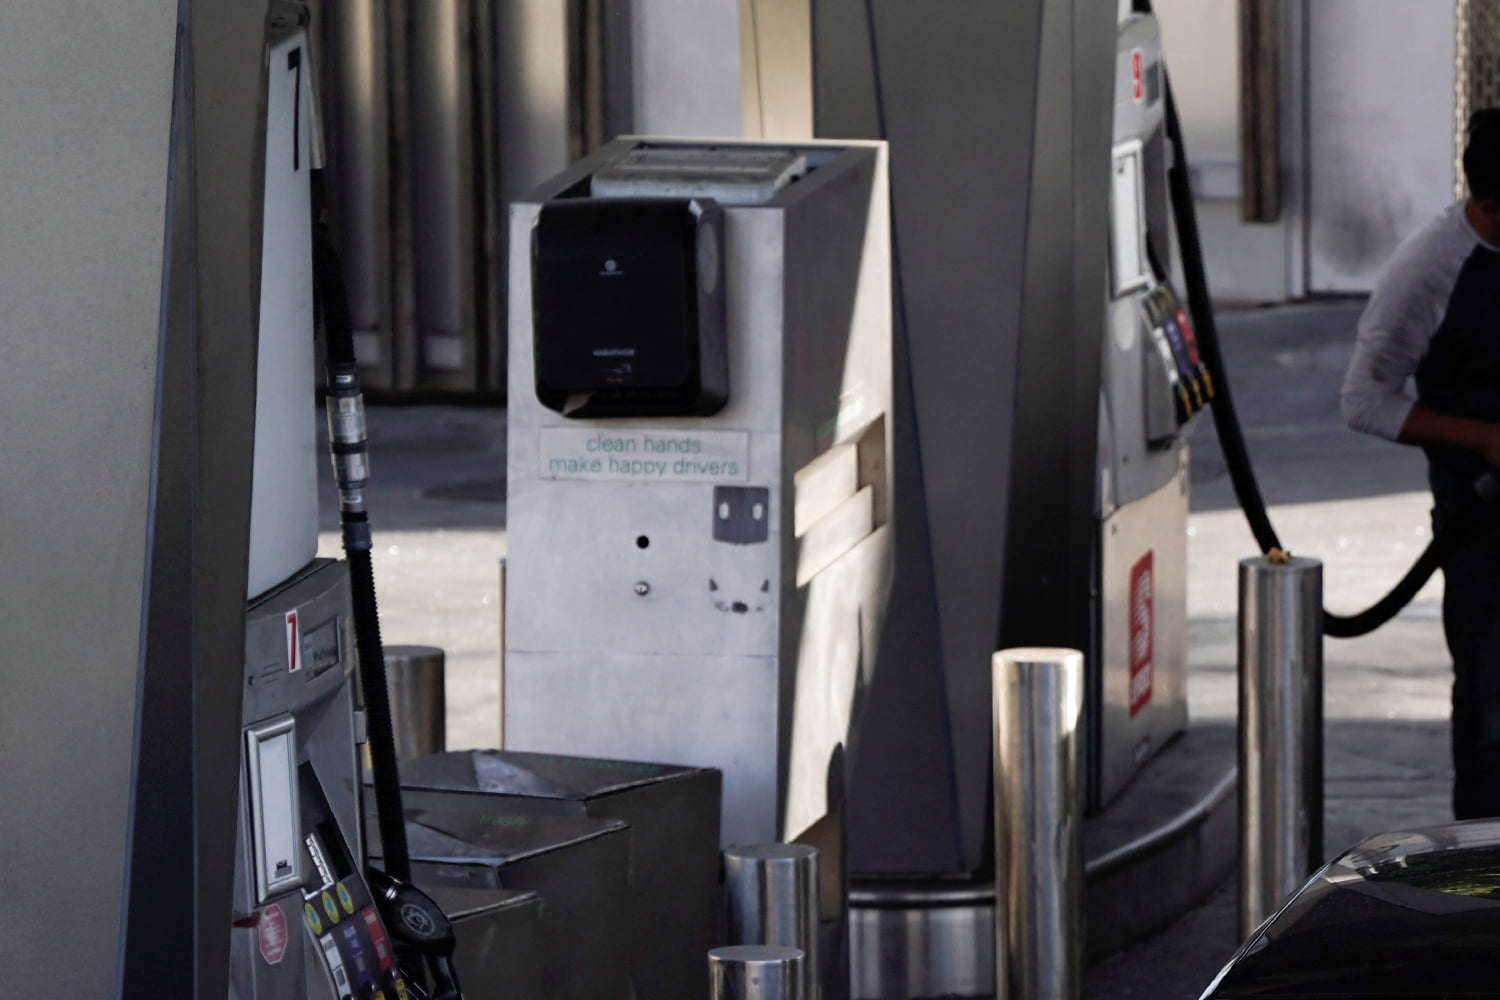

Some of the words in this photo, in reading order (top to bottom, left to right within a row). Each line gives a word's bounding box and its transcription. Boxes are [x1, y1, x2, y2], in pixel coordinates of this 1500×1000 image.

[585, 434, 637, 453] clean
[643, 435, 702, 455] hands
[549, 456, 602, 474] make
[609, 456, 666, 477] happy
[673, 457, 739, 476] drivers
